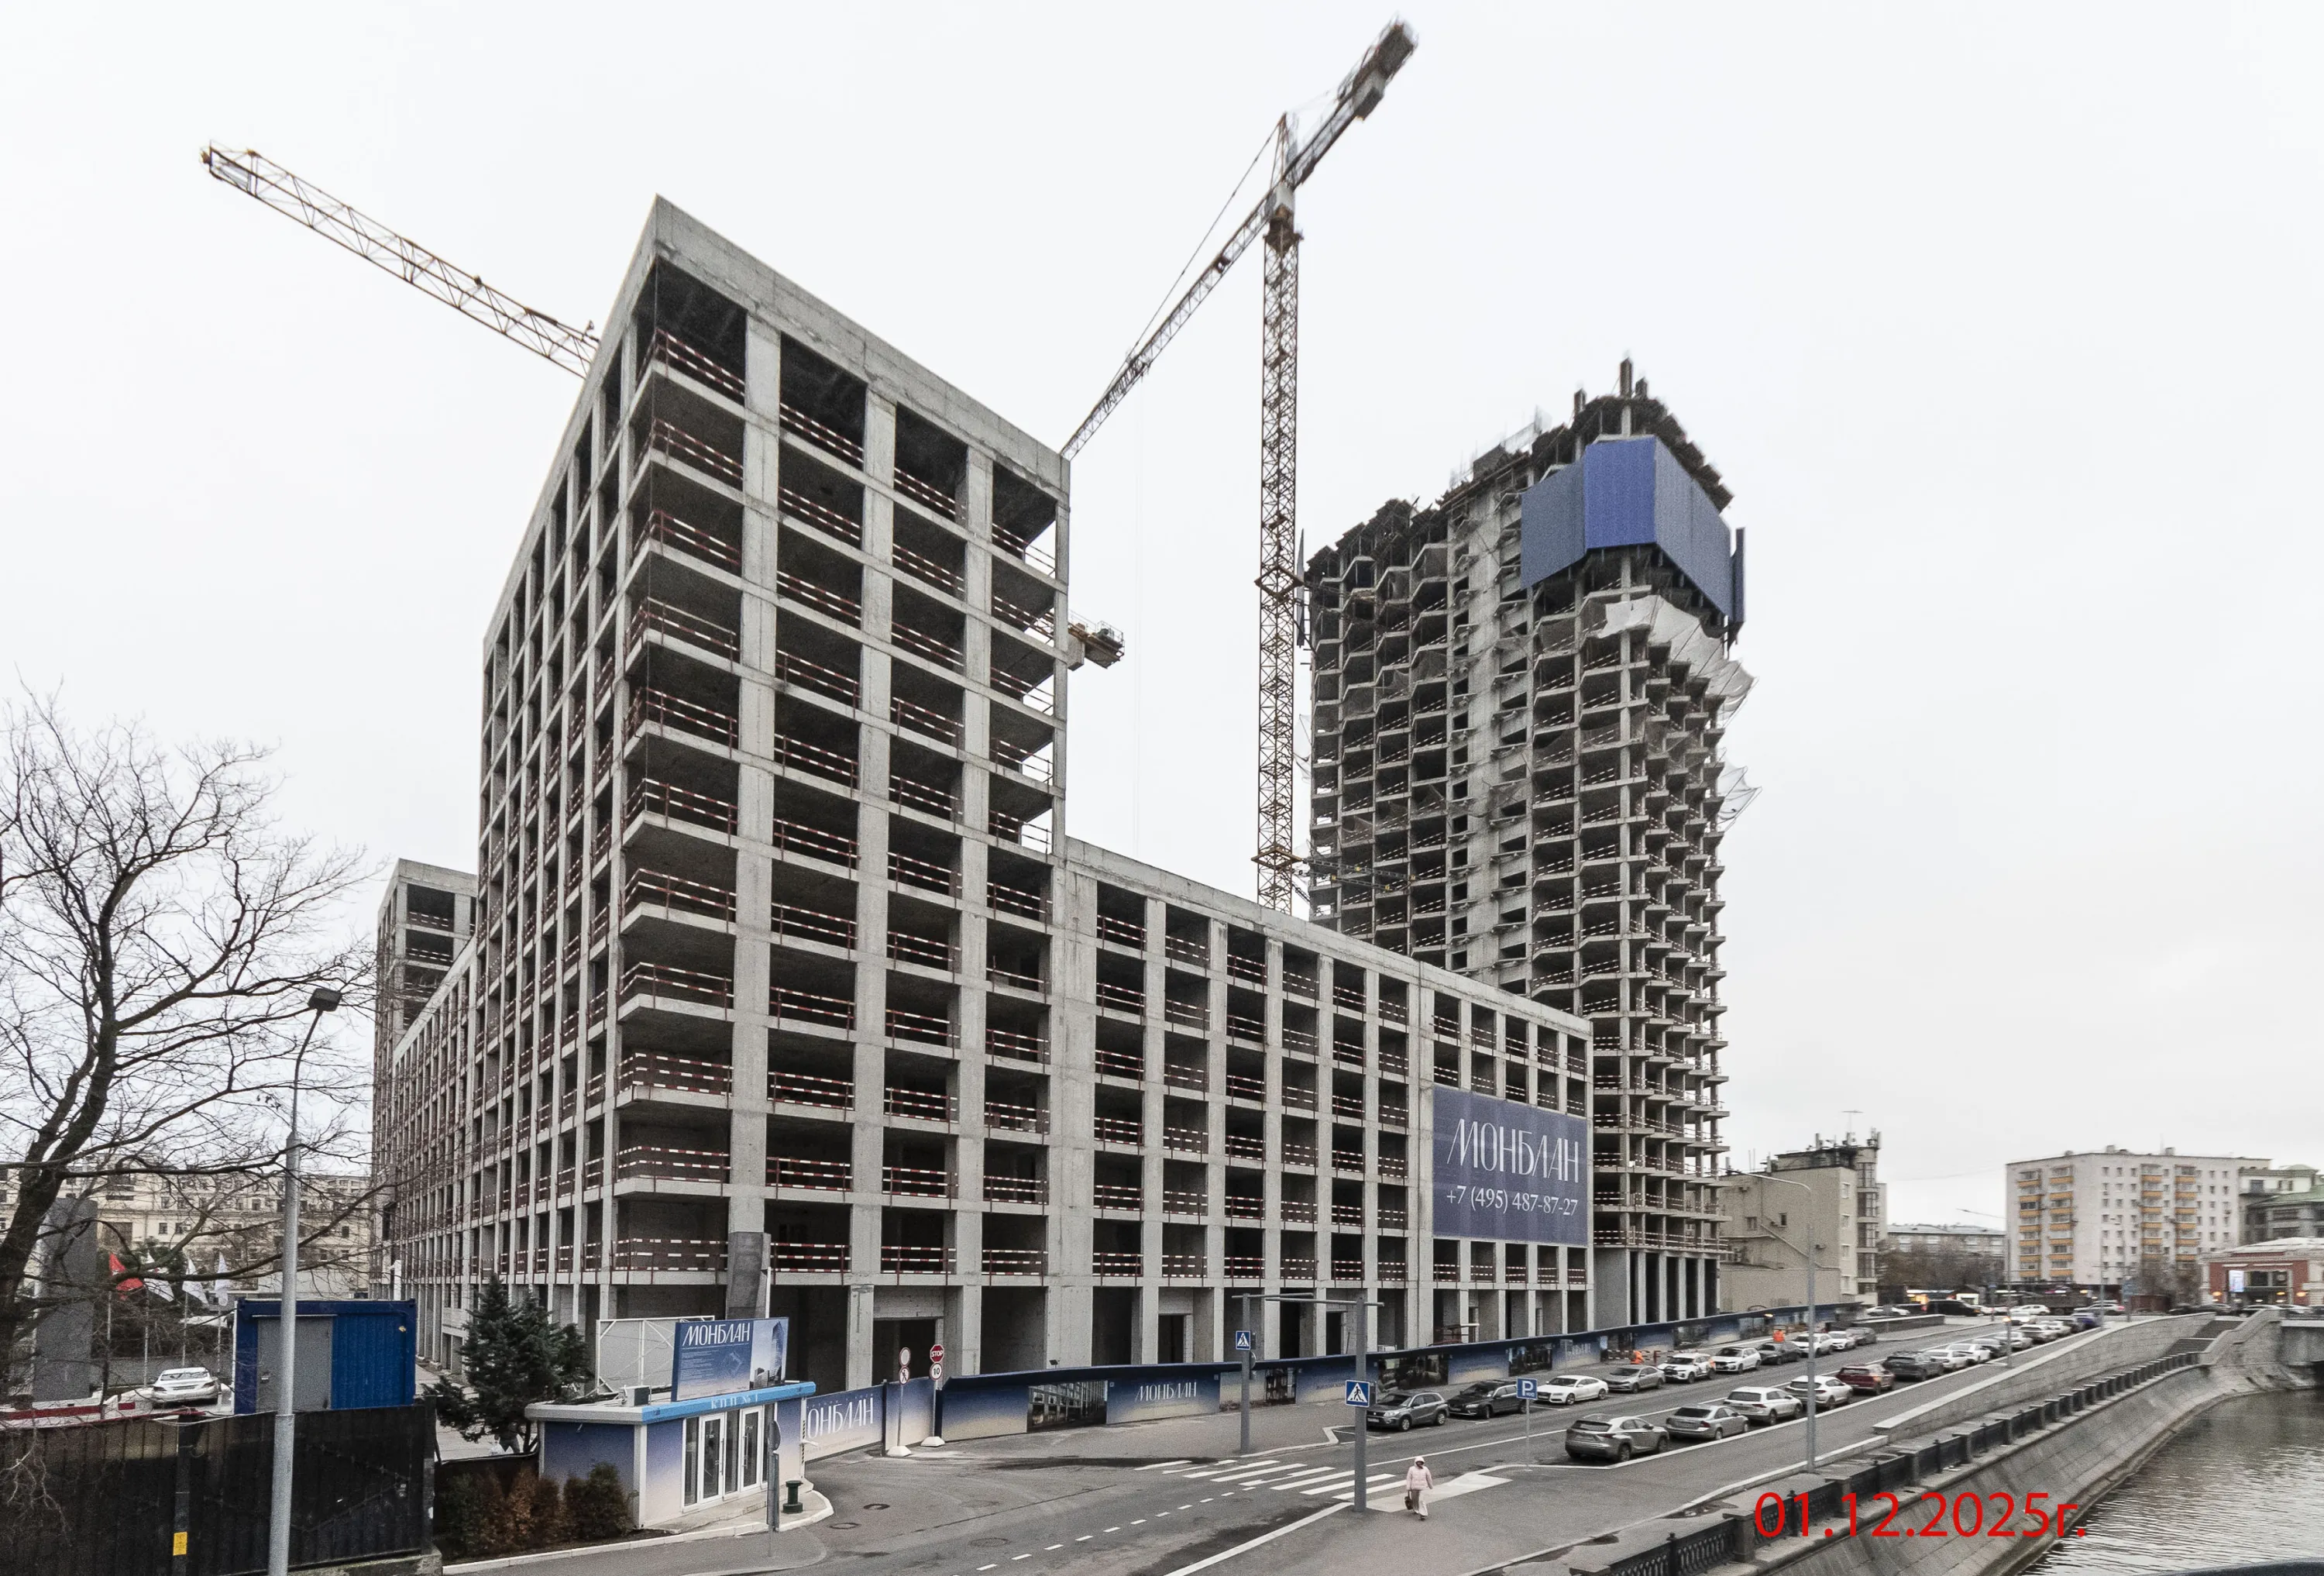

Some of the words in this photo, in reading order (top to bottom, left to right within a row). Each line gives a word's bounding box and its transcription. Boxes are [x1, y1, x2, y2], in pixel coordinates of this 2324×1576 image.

[1446, 1118, 1579, 1183] МОНБЛАН
[1446, 1185, 1467, 1204] +7
[1471, 1185, 1508, 1214] (495)
[1511, 1192, 1579, 1216] 487-87-27
[682, 1322, 751, 1347] МОНБЛАН
[1134, 1382, 1198, 1402] МОНБЛАН
[1521, 1380, 1534, 1396] P
[807, 1397, 874, 1440] ОНБЛАН
